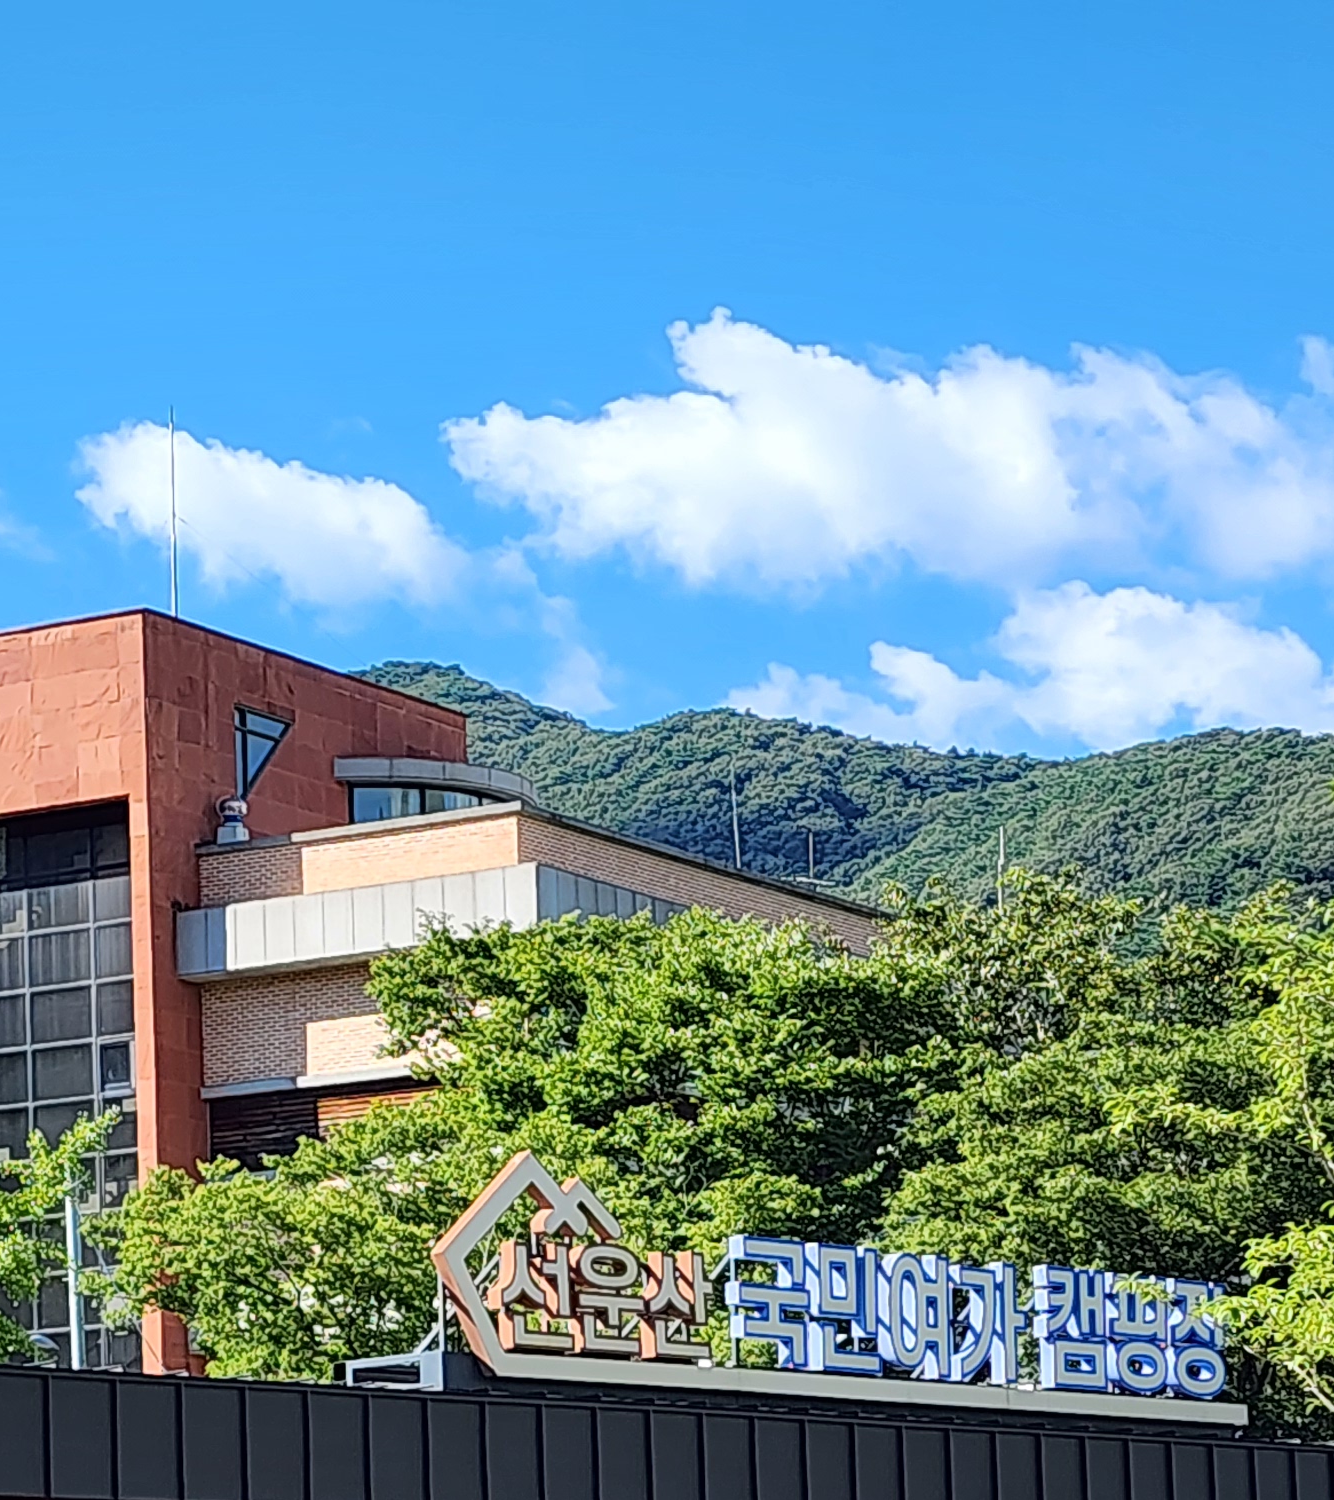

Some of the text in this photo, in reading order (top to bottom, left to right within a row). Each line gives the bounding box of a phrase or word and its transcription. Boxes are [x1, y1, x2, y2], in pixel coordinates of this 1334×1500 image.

[499, 1234, 1227, 1400] 선운산 국민여가 캠핑장
